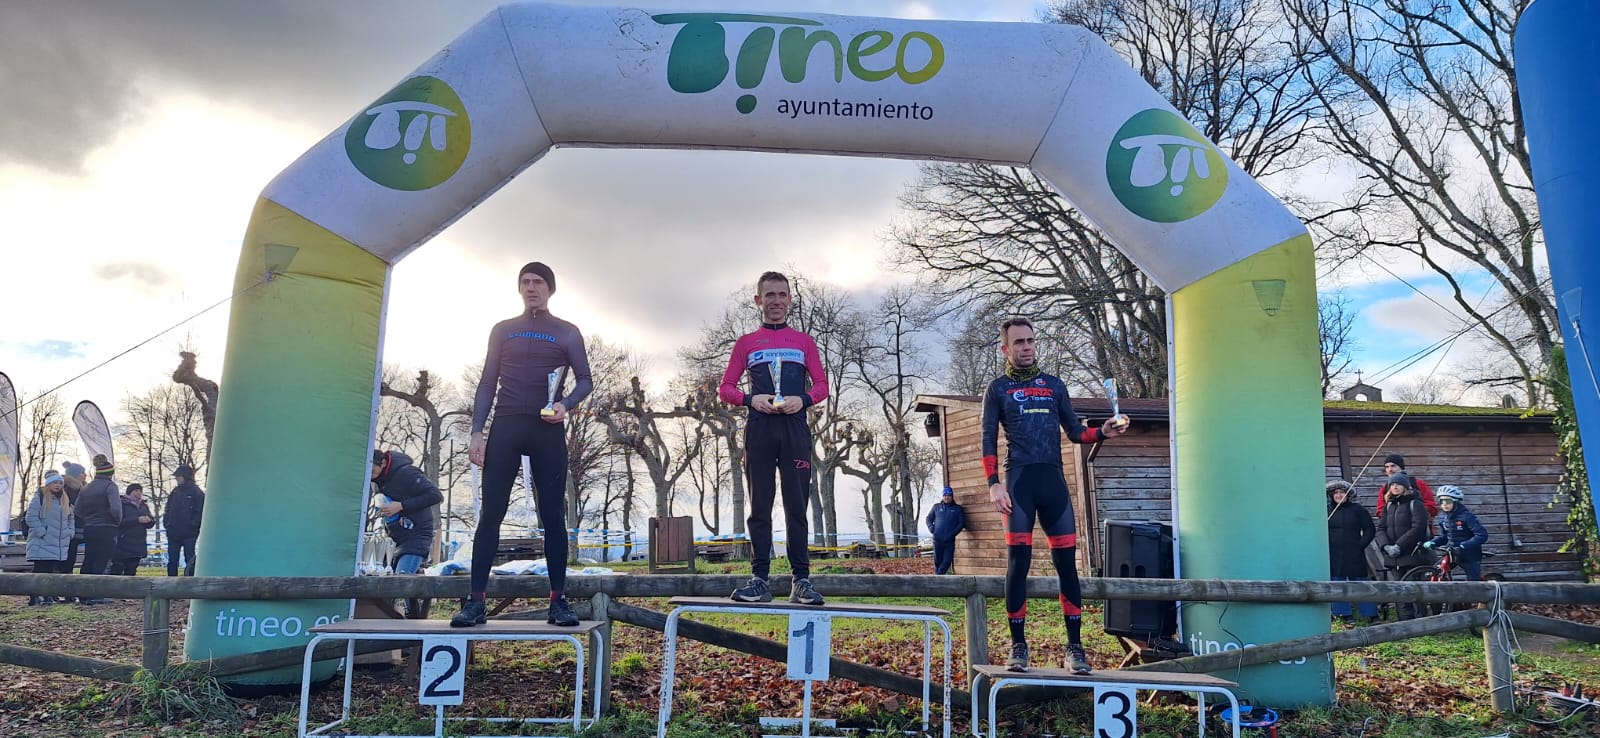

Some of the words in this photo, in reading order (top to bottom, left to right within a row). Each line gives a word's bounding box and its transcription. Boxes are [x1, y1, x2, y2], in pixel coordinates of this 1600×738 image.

[777, 98, 934, 120] ayuntamiento
[424, 644, 461, 698] 2
[793, 621, 815, 675] 1
[1097, 691, 1134, 738] 3
